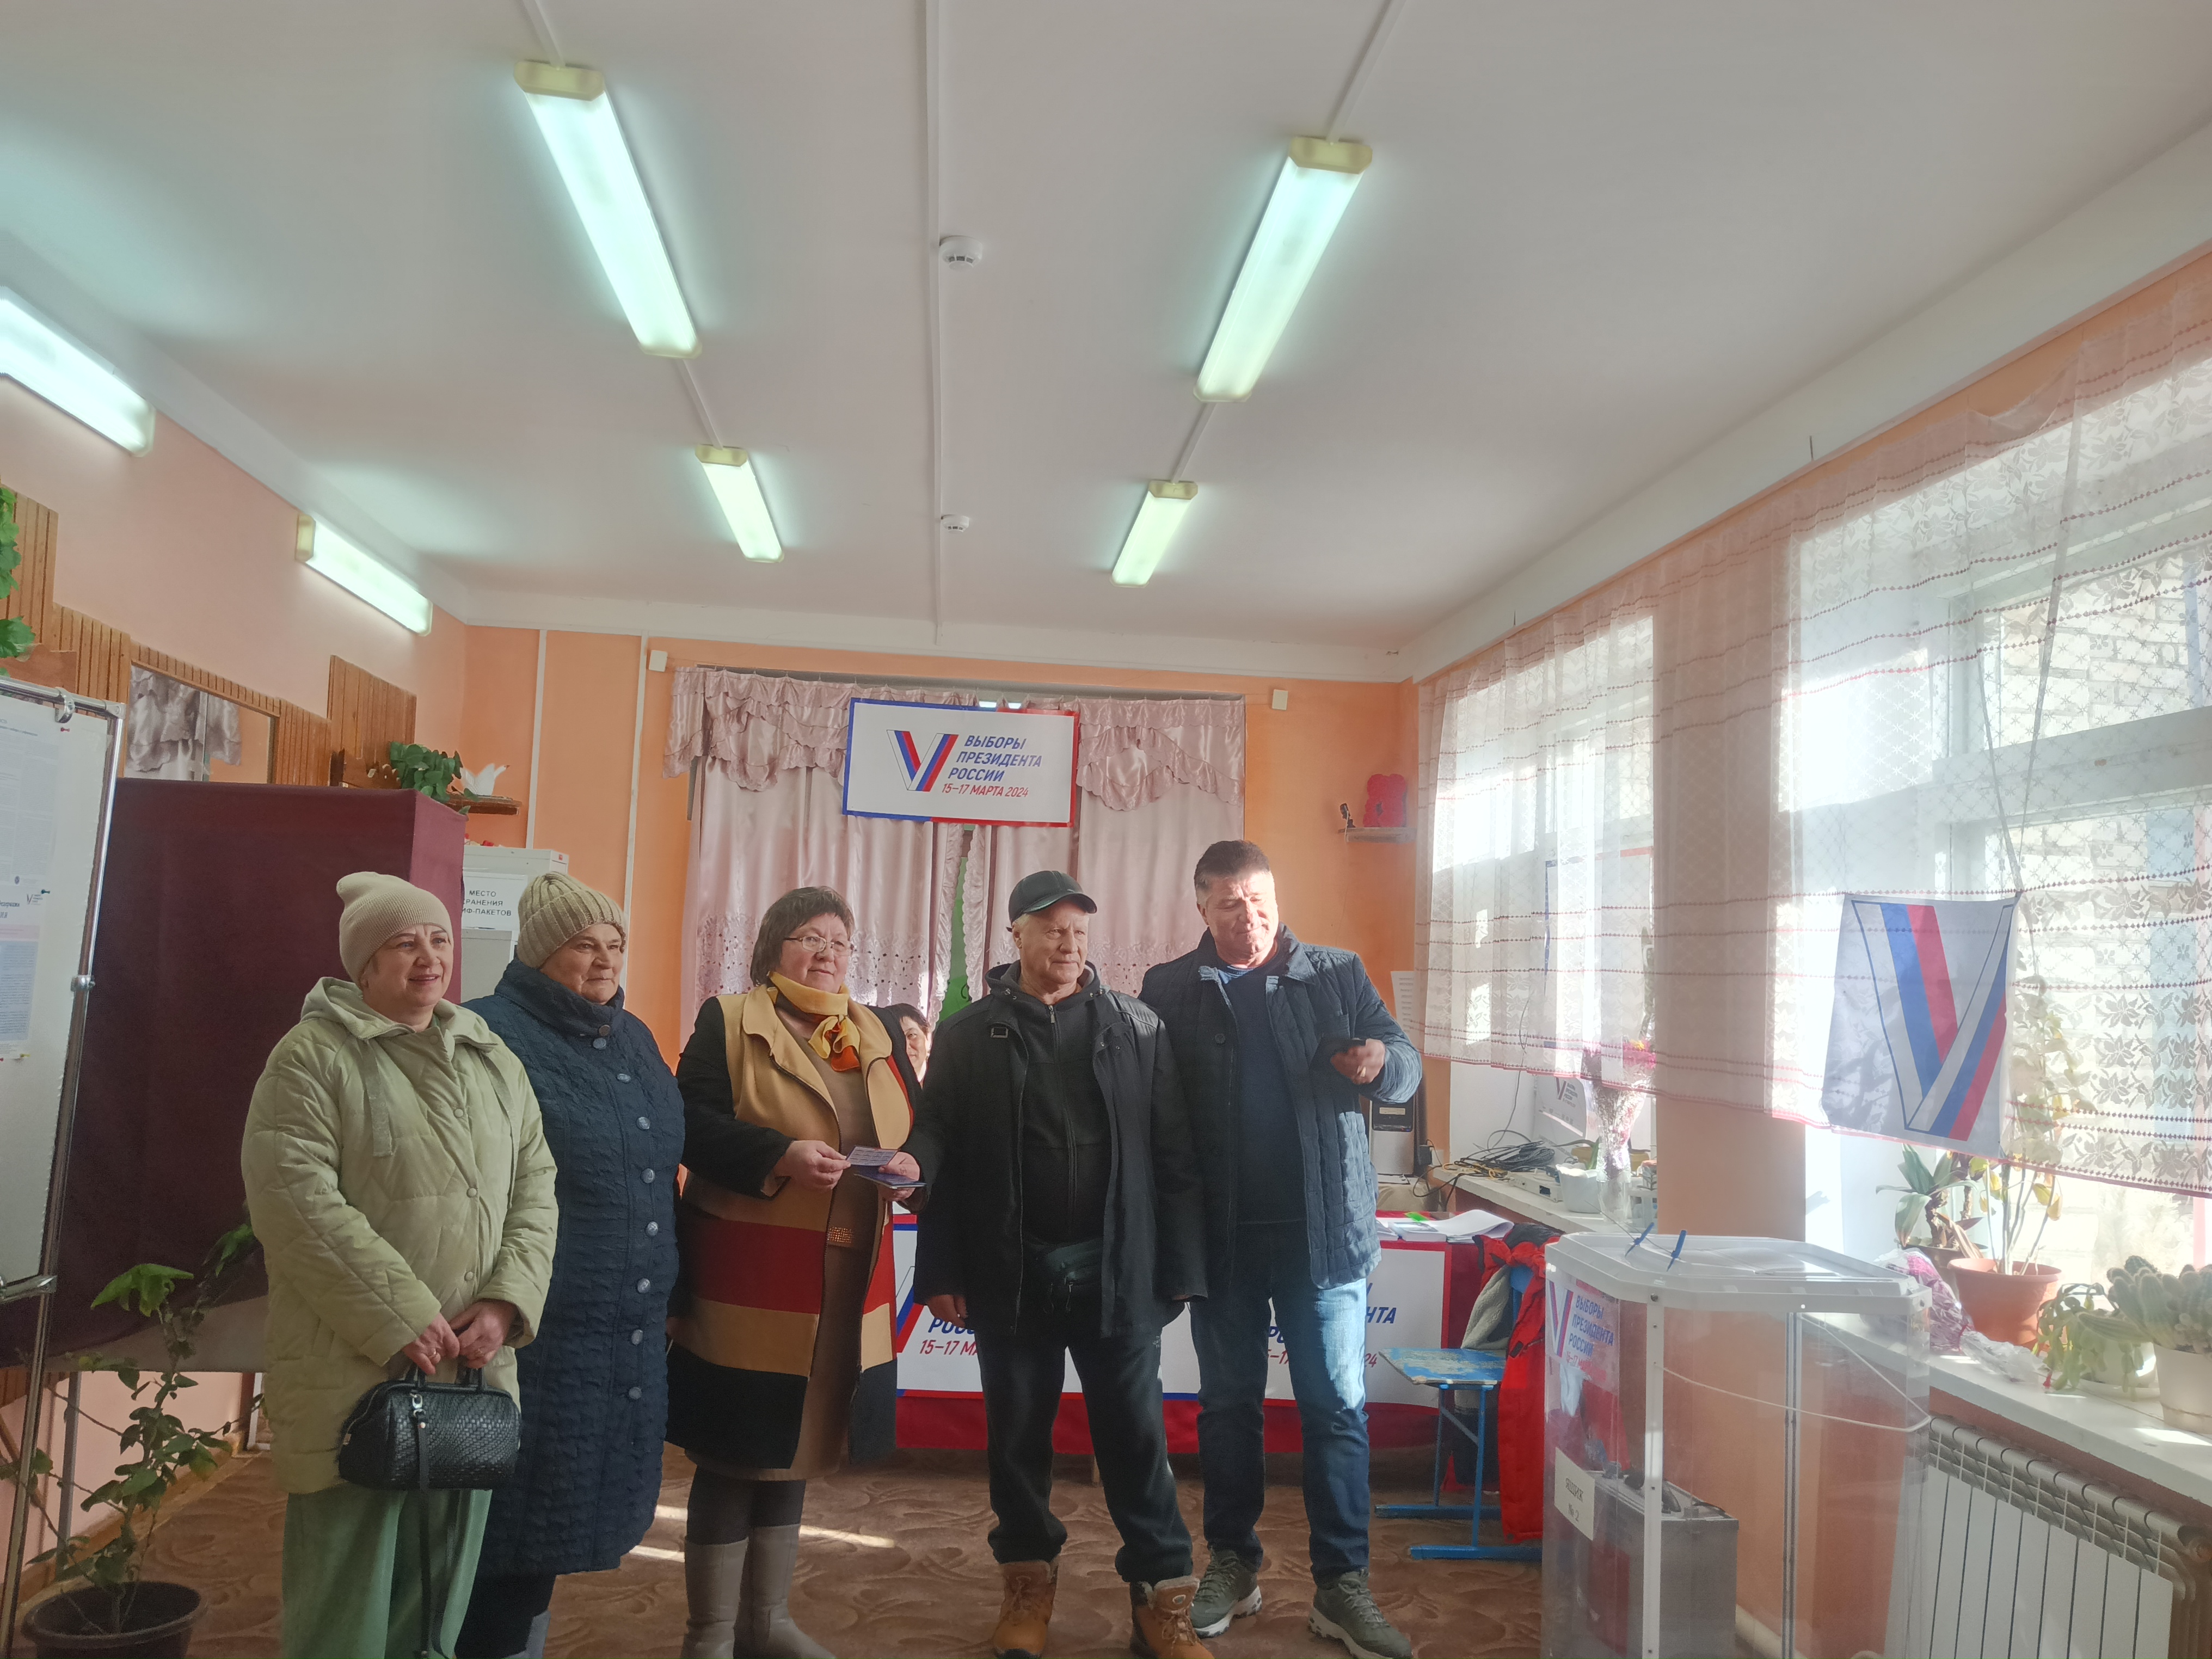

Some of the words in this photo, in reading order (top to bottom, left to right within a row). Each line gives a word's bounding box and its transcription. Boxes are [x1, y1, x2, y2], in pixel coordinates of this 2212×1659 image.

[964, 735, 1027, 749] ВЫБОРЫ
[956, 751, 1042, 767] ПРЕЗИДЕНТА
[948, 767, 1005, 782] РОССИИ
[970, 785, 1004, 796] МАРТА
[1005, 787, 1029, 797] 2024
[462, 907, 512, 916] ИФ-ПАКЕТОВ
[1576, 1295, 1604, 1319] ВЫБОРЫ
[1366, 1307, 1397, 1324] НТА
[1572, 1314, 1614, 1347] ПРЕЗИДЕНТА
[1569, 1333, 1594, 1357] РОССИИ
[1565, 1477, 1584, 1502] ЯЩИК
